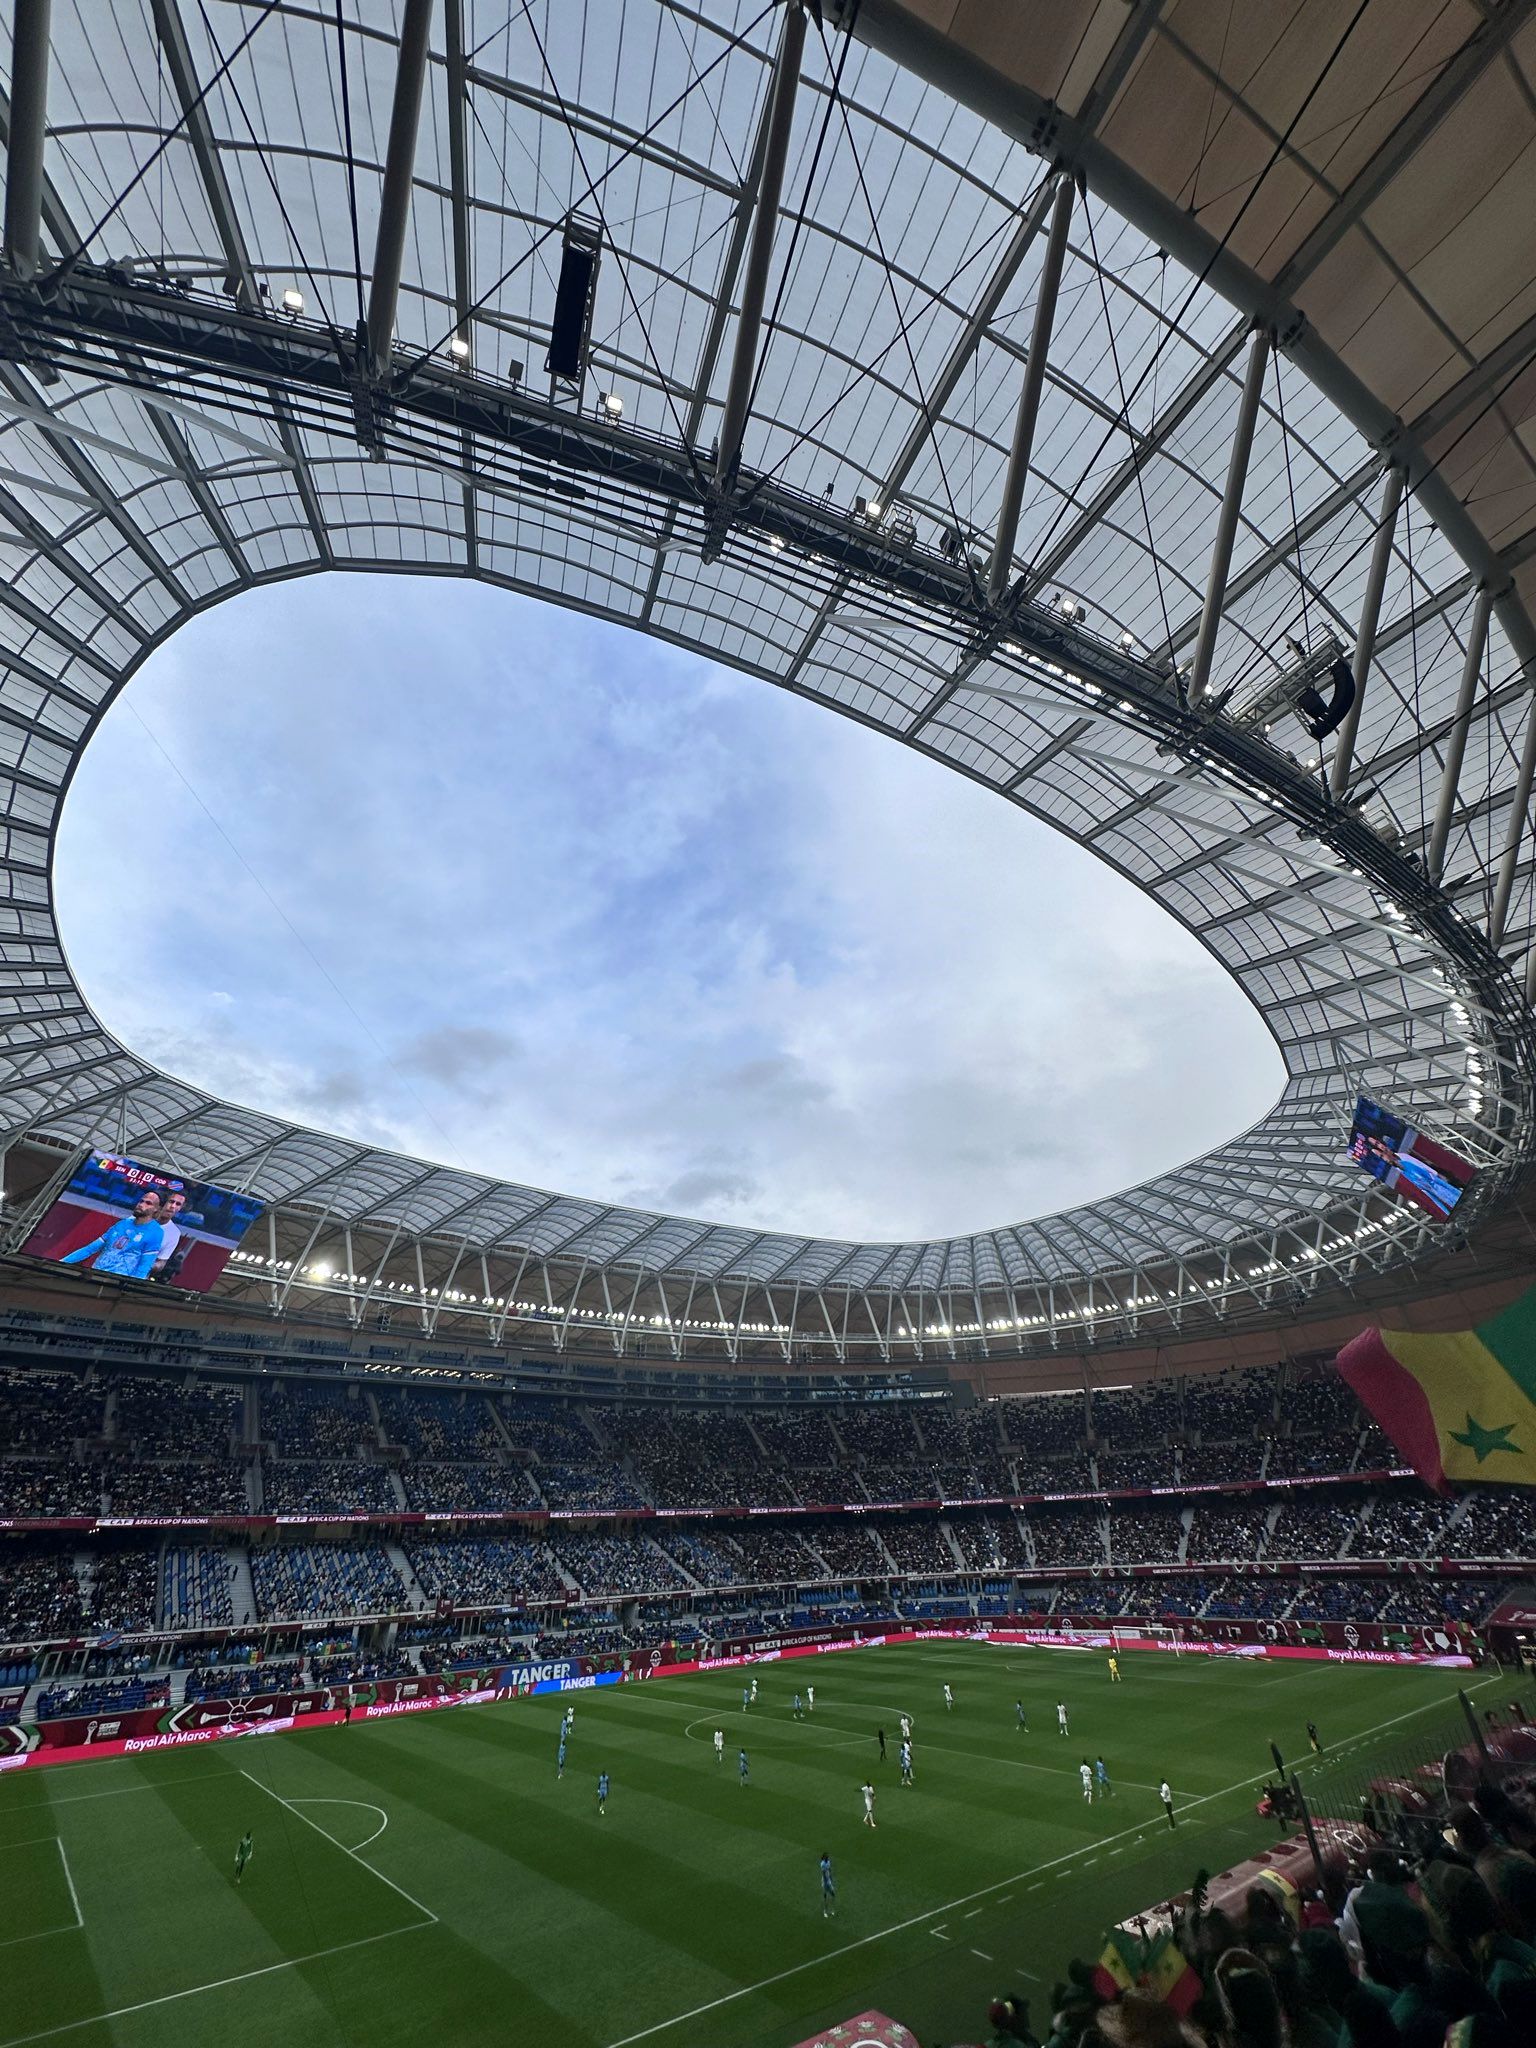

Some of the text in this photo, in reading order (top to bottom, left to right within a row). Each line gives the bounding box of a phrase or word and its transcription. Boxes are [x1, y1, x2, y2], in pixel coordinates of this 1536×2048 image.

[115, 1165, 127, 1173] SEN
[1187, 1642, 1209, 1651] Maroc
[1327, 1649, 1396, 1661] Royal Air Maroc
[698, 1660, 715, 1669] Royal
[725, 1658, 740, 1666] Maroc
[512, 1663, 570, 1685] TANGER
[560, 1676, 596, 1690] TANGER
[367, 1700, 432, 1717] Royal Air Maroc
[125, 1731, 211, 1752] Royal Air Maroc
